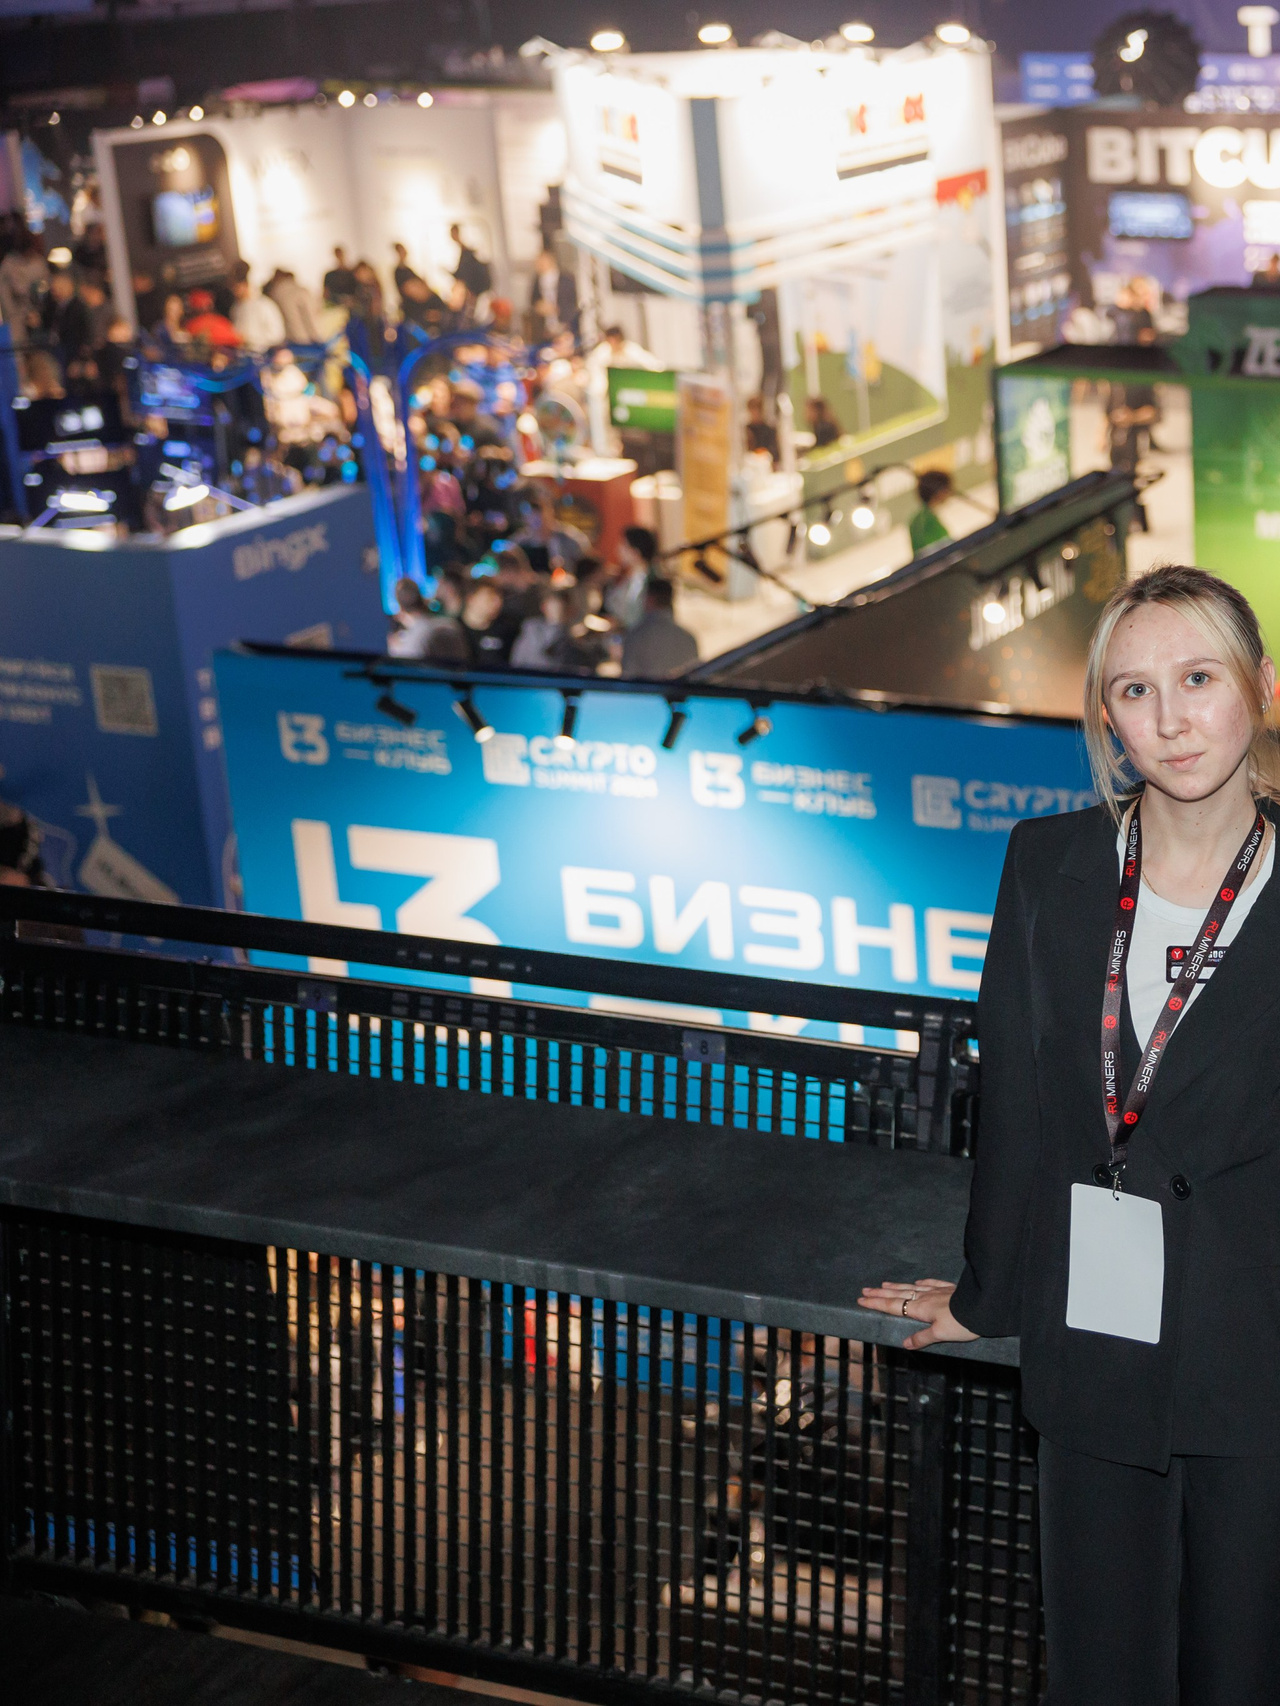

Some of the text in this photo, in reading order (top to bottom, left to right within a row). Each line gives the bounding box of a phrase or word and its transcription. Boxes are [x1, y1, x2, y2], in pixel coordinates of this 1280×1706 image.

[529, 735, 657, 776] CRYPTO
[1125, 819, 1138, 878] RUMINERS
[1237, 812, 1264, 872] RUMINERS
[561, 865, 992, 989] БИЗНЕ
[1185, 920, 1219, 979] RUMINERS
[1107, 930, 1126, 992] RUMINERS
[700, 1040, 709, 1055] 8
[1137, 1030, 1167, 1093] RUMINERS
[1104, 1051, 1118, 1114] RUMINERS
